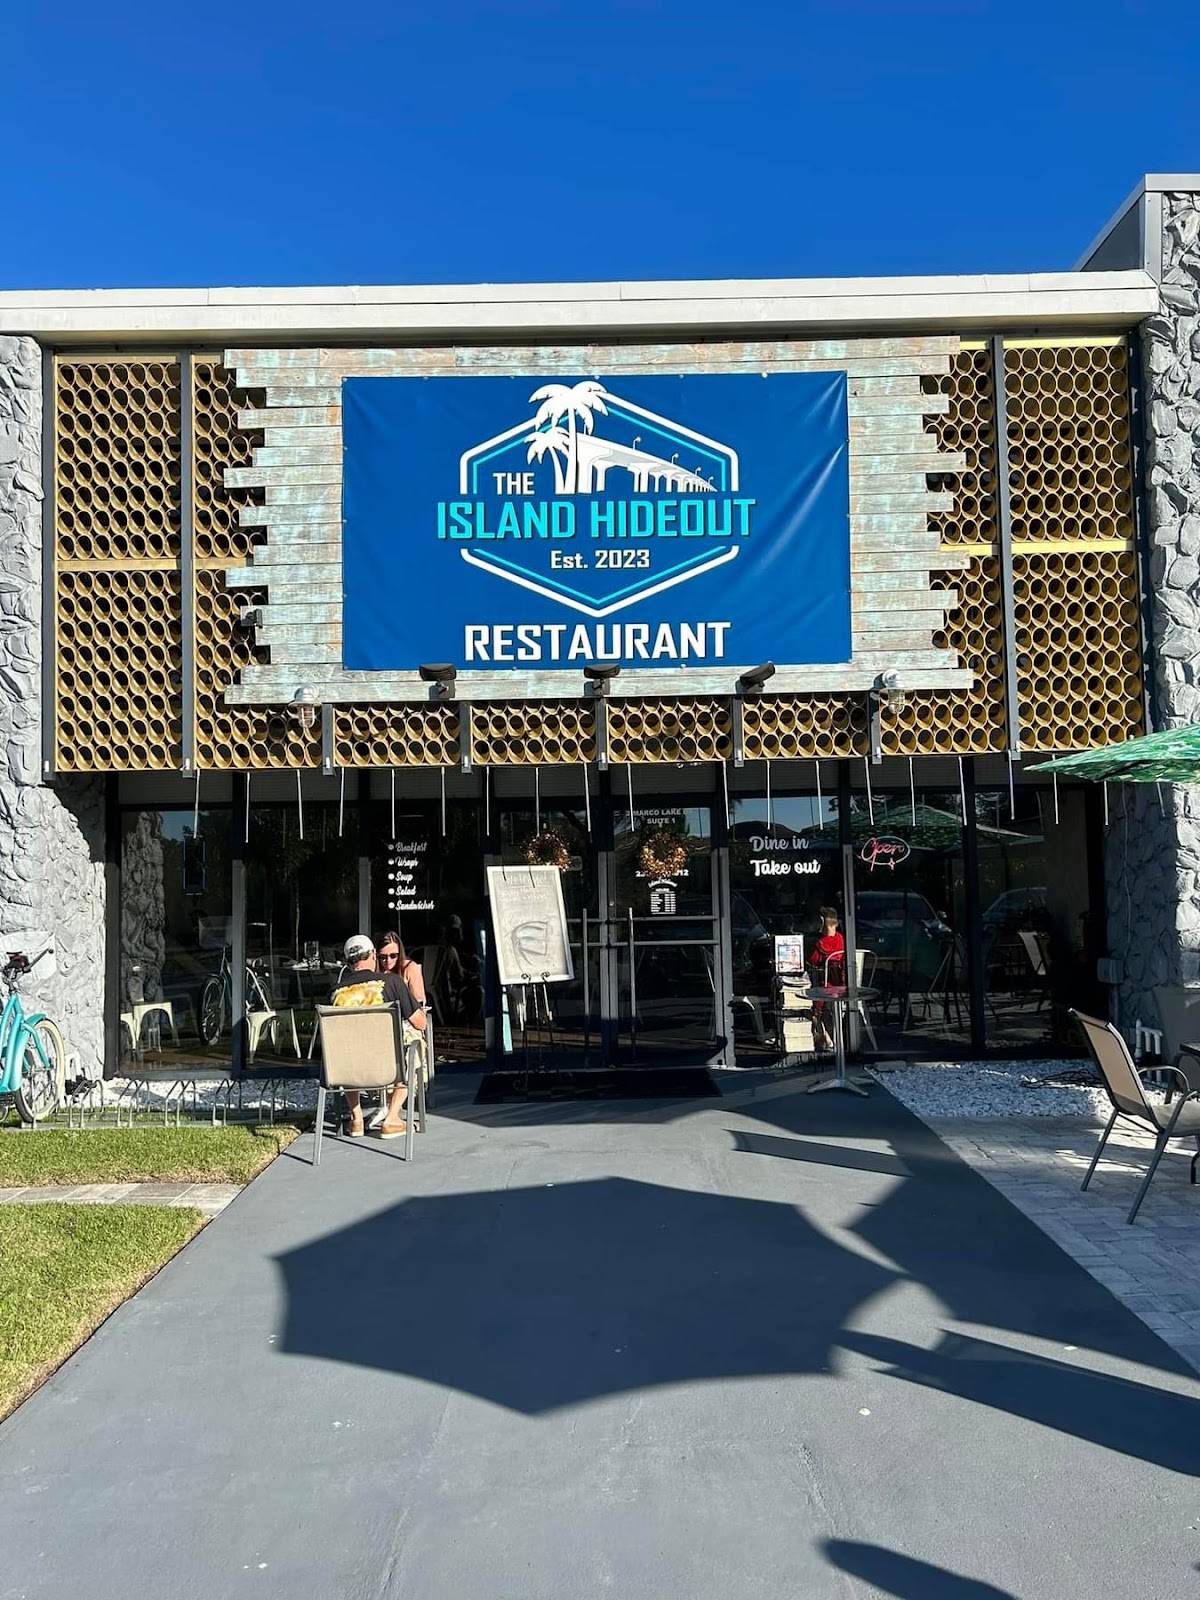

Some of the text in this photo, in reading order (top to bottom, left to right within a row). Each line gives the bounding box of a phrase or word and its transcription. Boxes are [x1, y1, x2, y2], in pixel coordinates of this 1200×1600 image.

[492, 472, 536, 495] THE
[436, 498, 756, 540] ISLAND HIDEOUT
[550, 549, 651, 569] Est. 2023
[464, 621, 732, 662] RESTAURANT
[647, 817, 670, 825] SUITE
[661, 808, 682, 816] LAKE
[749, 835, 810, 852] Dine in
[749, 858, 822, 877] Take out
[395, 885, 417, 896] Salad
